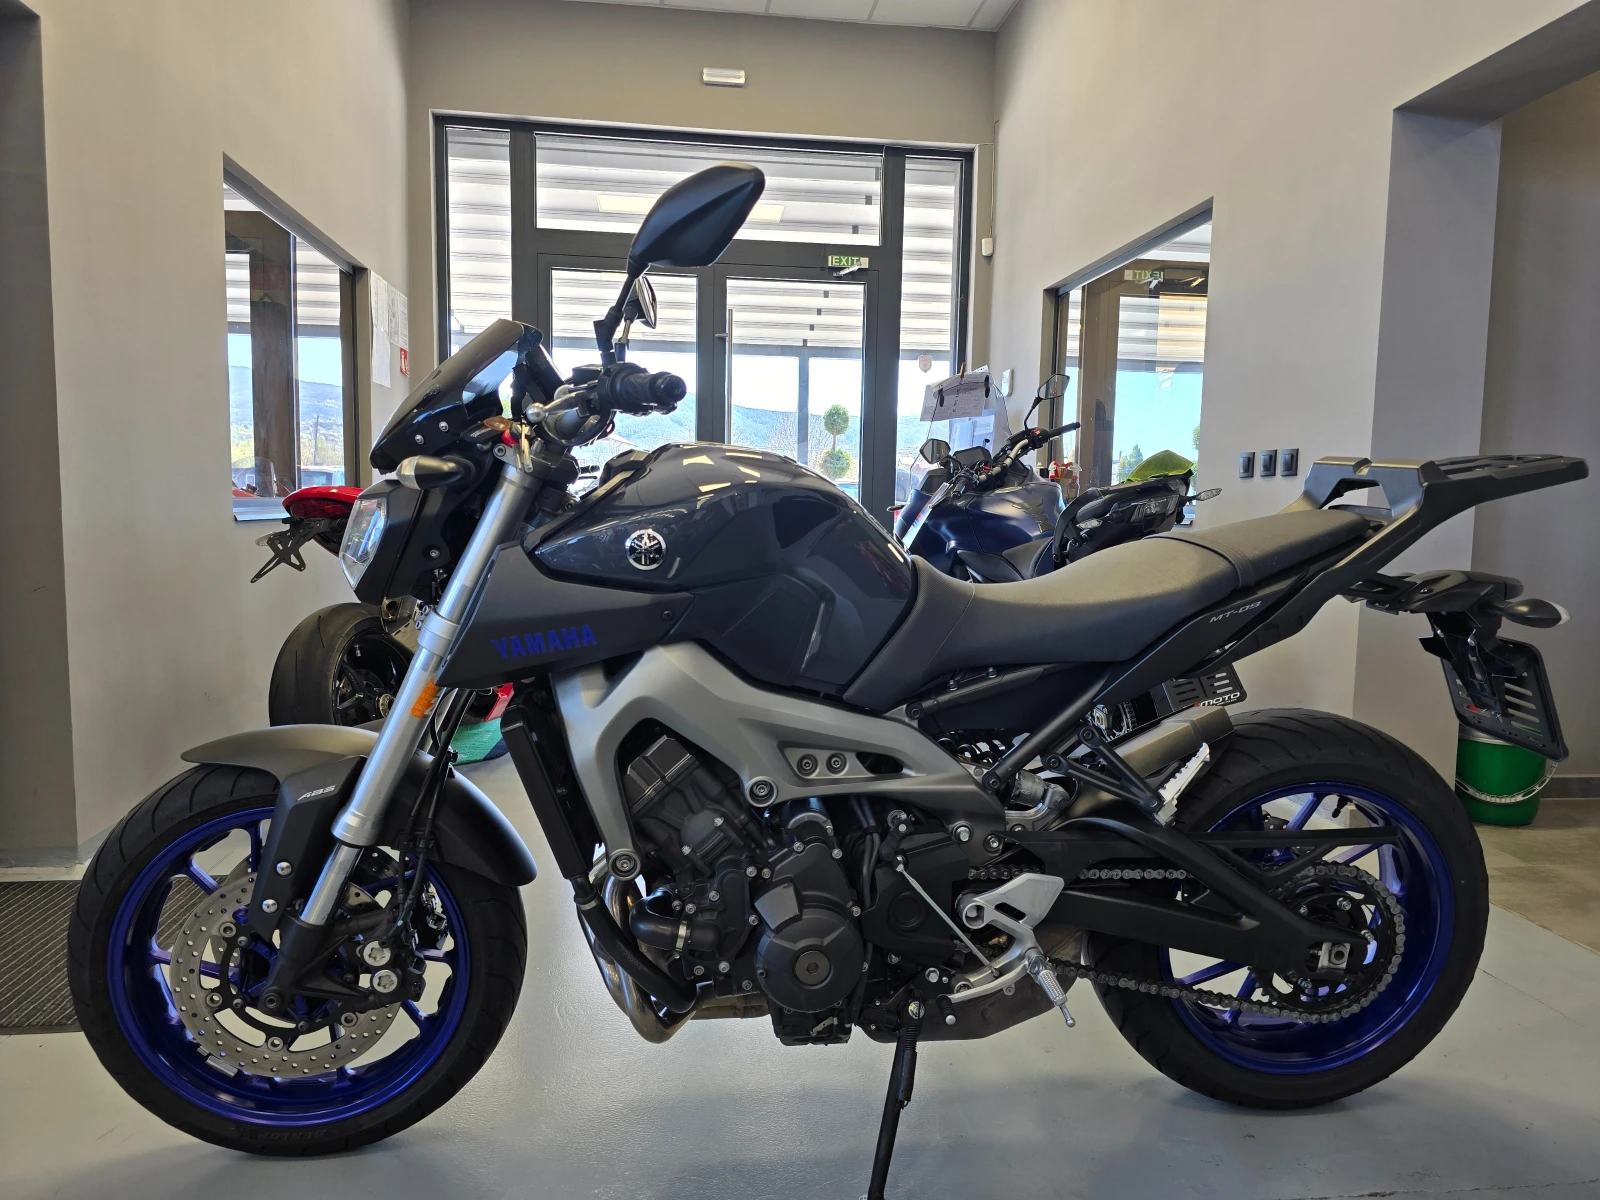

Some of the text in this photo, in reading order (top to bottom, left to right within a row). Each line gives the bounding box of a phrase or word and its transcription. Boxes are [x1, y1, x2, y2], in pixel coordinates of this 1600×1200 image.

[832, 256, 859, 267] EXIT
[1209, 601, 1262, 623] MT-09
[491, 624, 598, 660] YAMAHA
[297, 784, 337, 801] ABS
